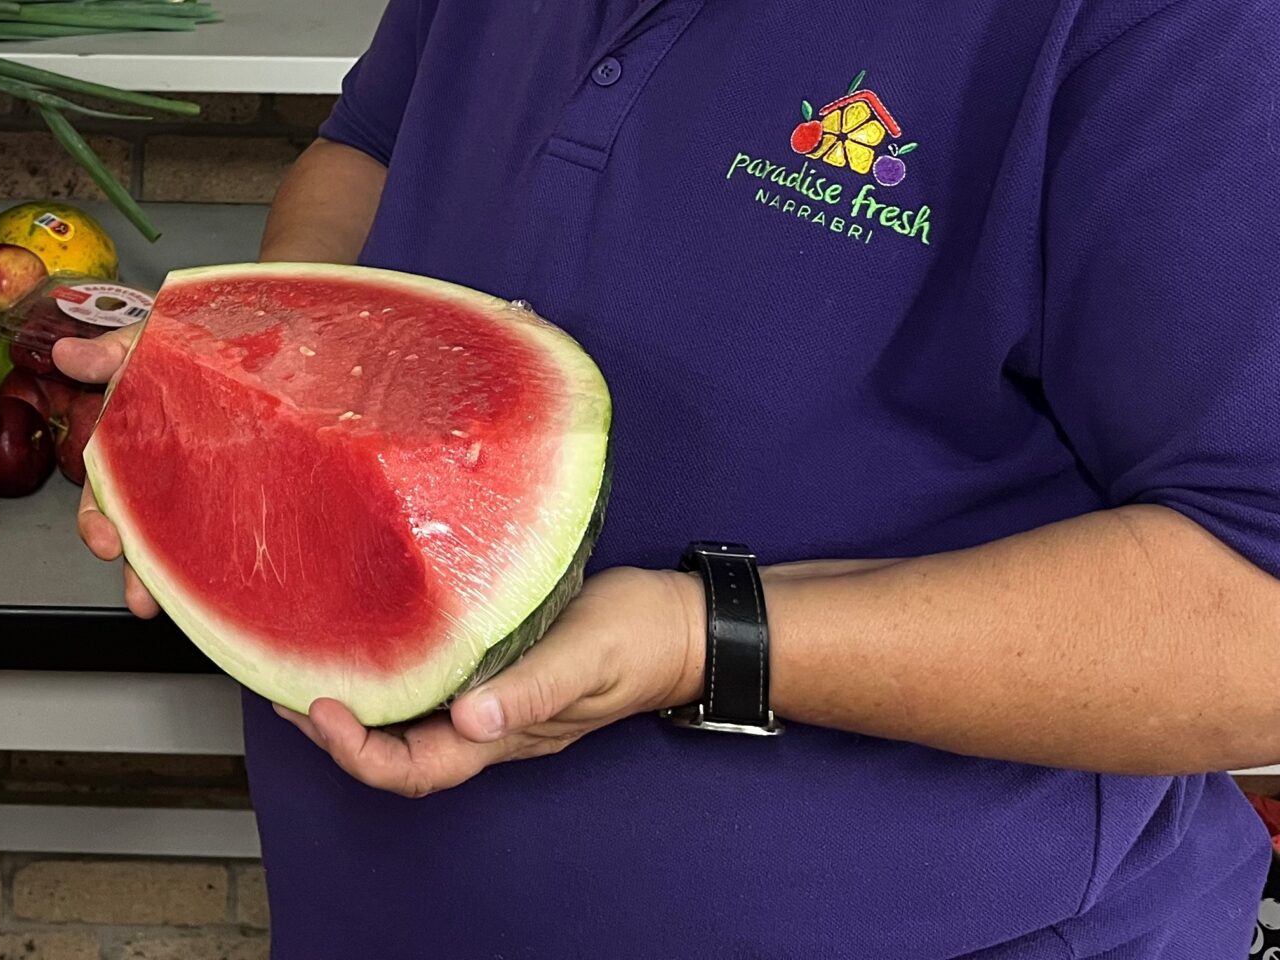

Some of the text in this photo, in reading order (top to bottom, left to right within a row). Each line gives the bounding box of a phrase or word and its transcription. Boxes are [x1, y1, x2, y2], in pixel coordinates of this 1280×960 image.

[727, 152, 930, 245] paradise fresh
[756, 189, 872, 244] NARRABRI
